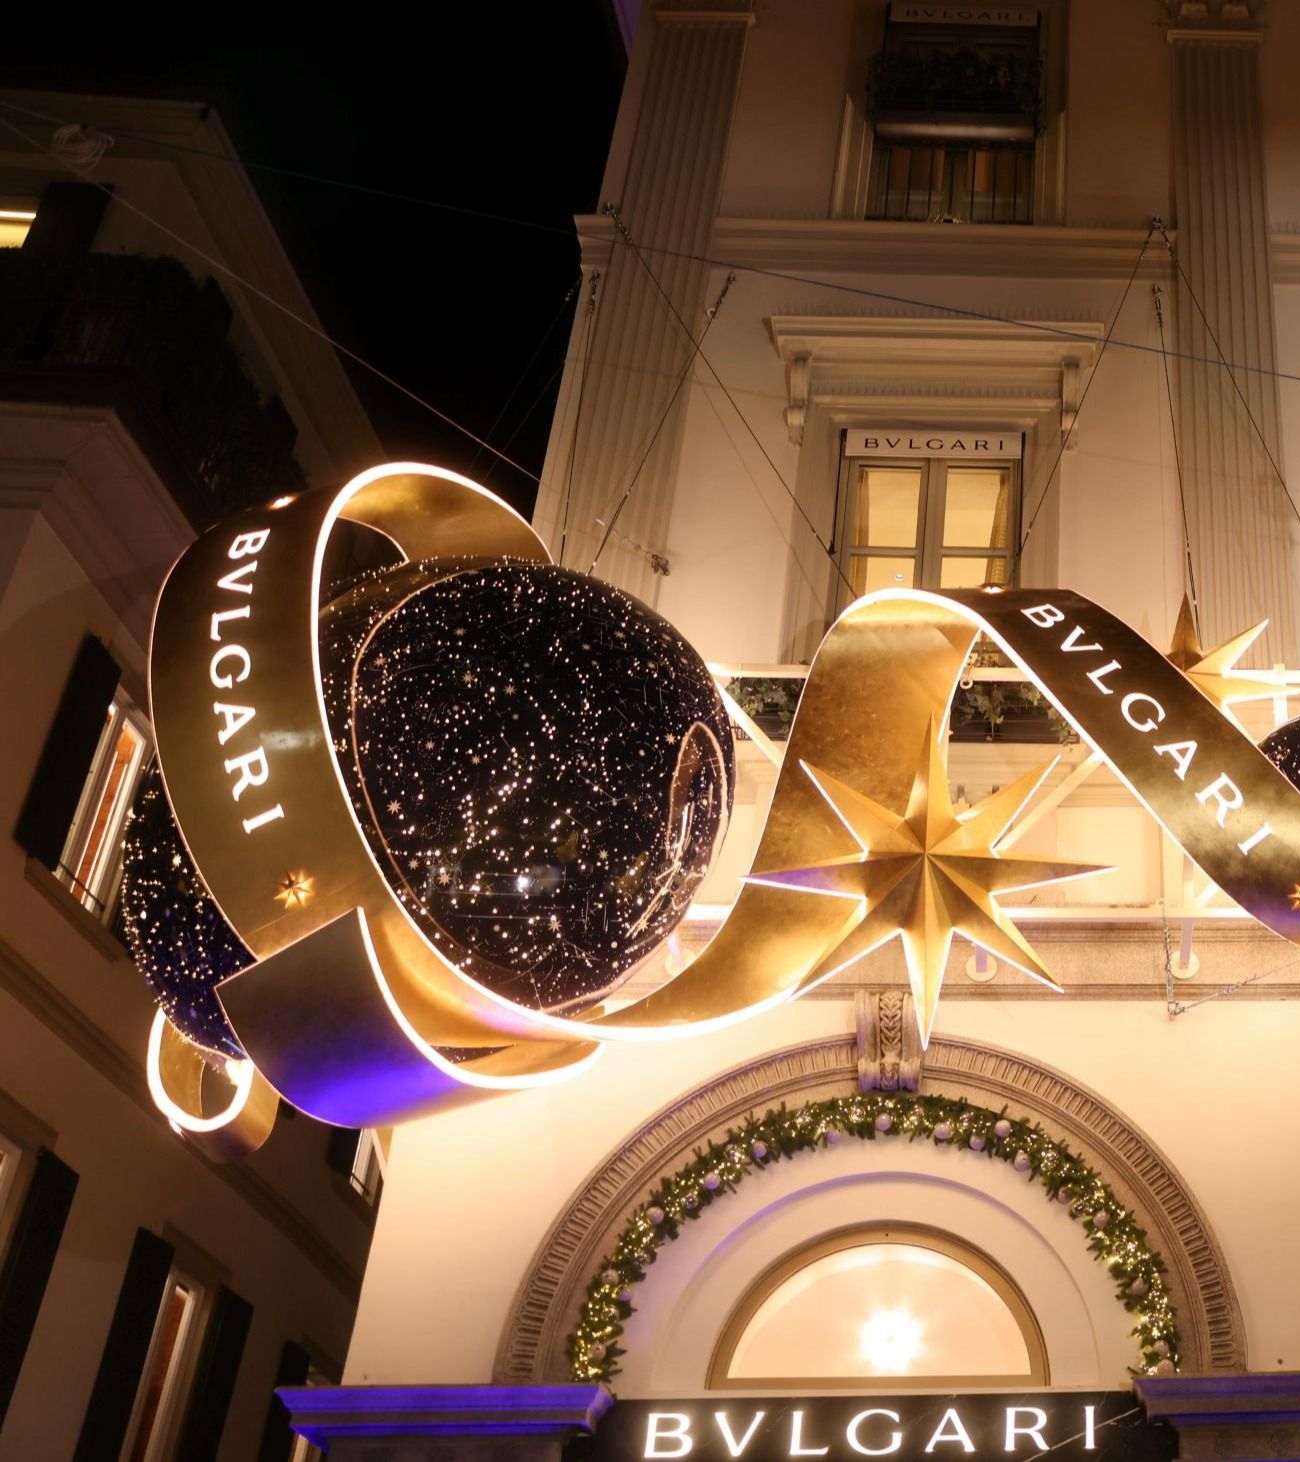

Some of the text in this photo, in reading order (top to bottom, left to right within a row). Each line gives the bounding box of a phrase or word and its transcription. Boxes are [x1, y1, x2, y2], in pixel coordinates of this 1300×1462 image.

[906, 9, 1022, 21] BVLGARI
[864, 438, 1004, 451] BVLGARI
[210, 528, 285, 834] BVLGARI
[1020, 603, 1275, 856] BVLGARI
[643, 1404, 1097, 1458] BVLGARI
